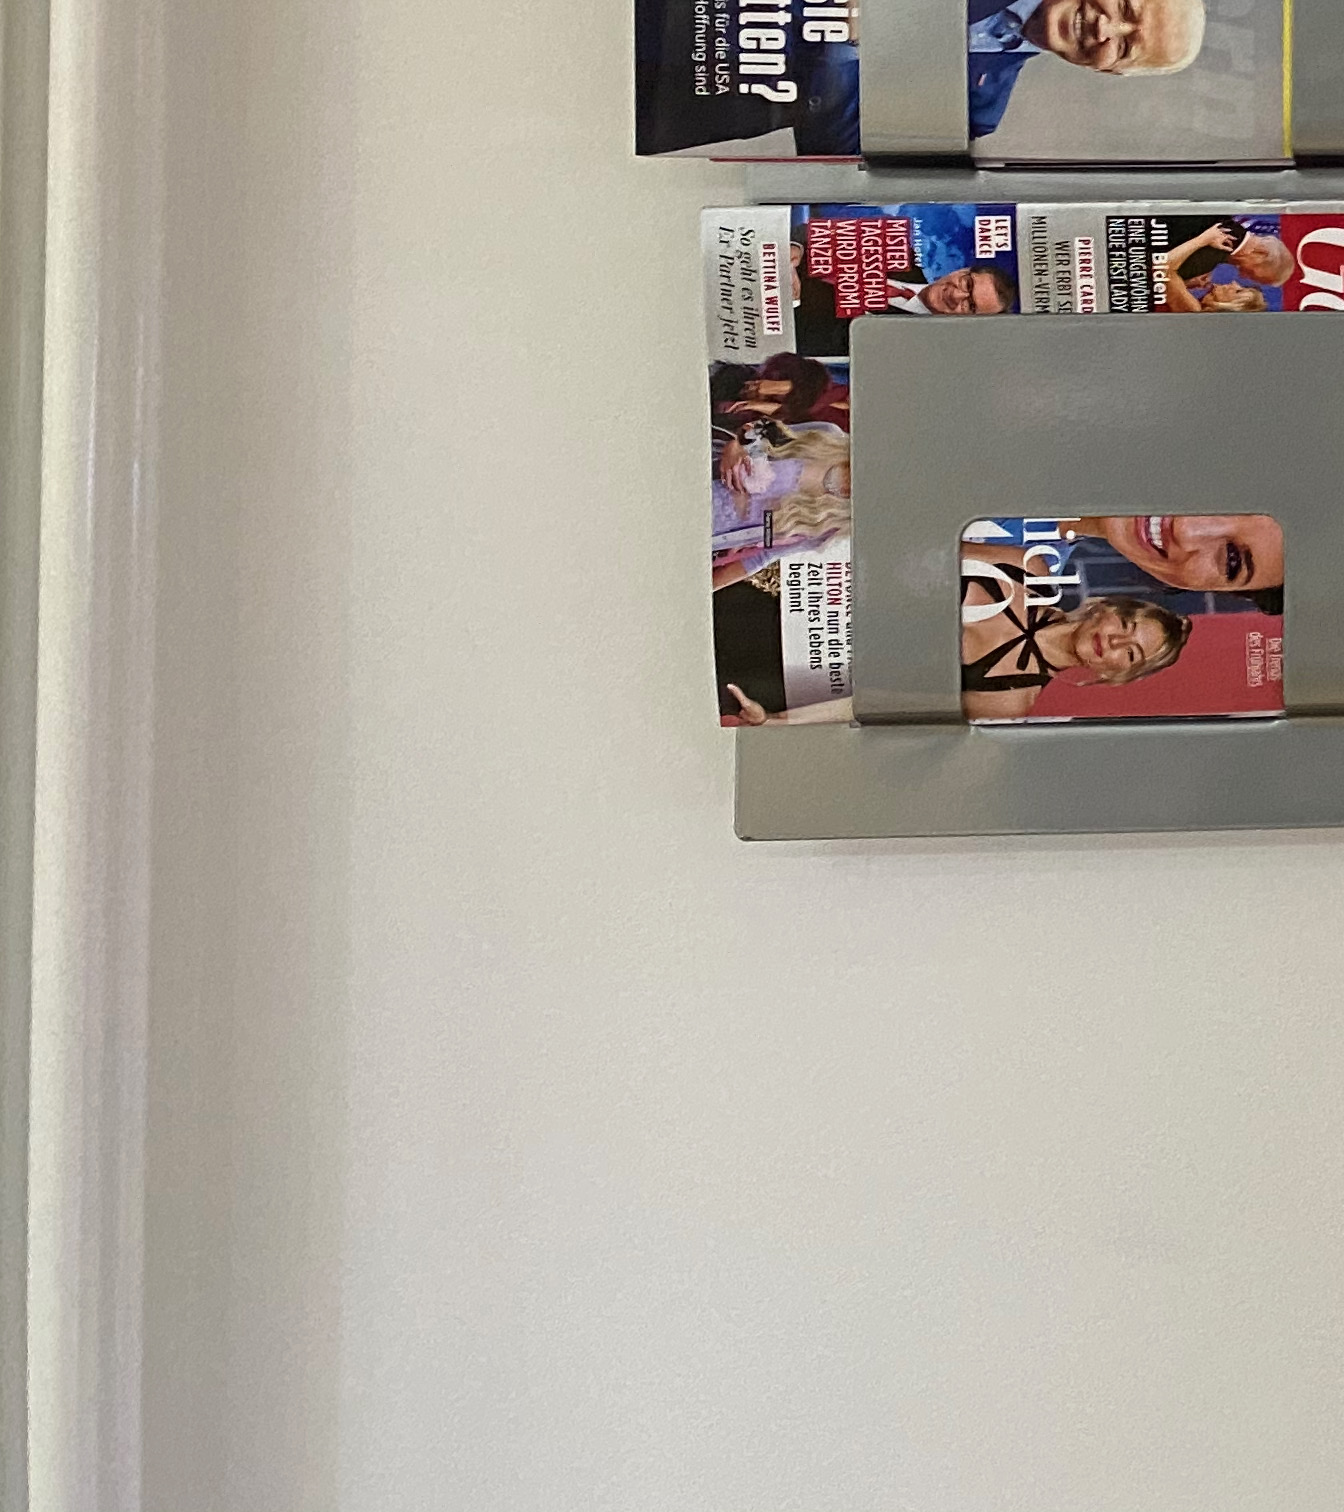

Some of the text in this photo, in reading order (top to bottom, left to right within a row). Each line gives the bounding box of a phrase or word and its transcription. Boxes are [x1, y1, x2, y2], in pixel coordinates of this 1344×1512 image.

[713, 12, 730, 34] für
[713, 37, 730, 59] die
[694, 65, 709, 96] sind
[713, 63, 730, 96] USA
[810, 219, 835, 276] TÄNZER
[886, 219, 908, 270] MISTER
[979, 219, 994, 256] DANCE
[994, 219, 1009, 249] LET'S
[1055, 241, 1072, 266] WER
[1128, 218, 1146, 244] EINE
[836, 219, 860, 315] WIRD PROMI-
[861, 219, 885, 308] TAGESSCHAU
[1056, 270, 1072, 296] ERBT
[1079, 239, 1093, 279] PIERRE
[1109, 218, 1130, 312] NEUE FIRST LADY
[1151, 218, 1171, 305] Jill Biden
[735, 227, 760, 349] So geht es ihrem
[763, 243, 780, 333] BETTINA WULFF
[786, 564, 805, 614] beginnt
[807, 563, 826, 670] Zeit ihres Lebens
[827, 562, 846, 695] HILTON nun die beste
